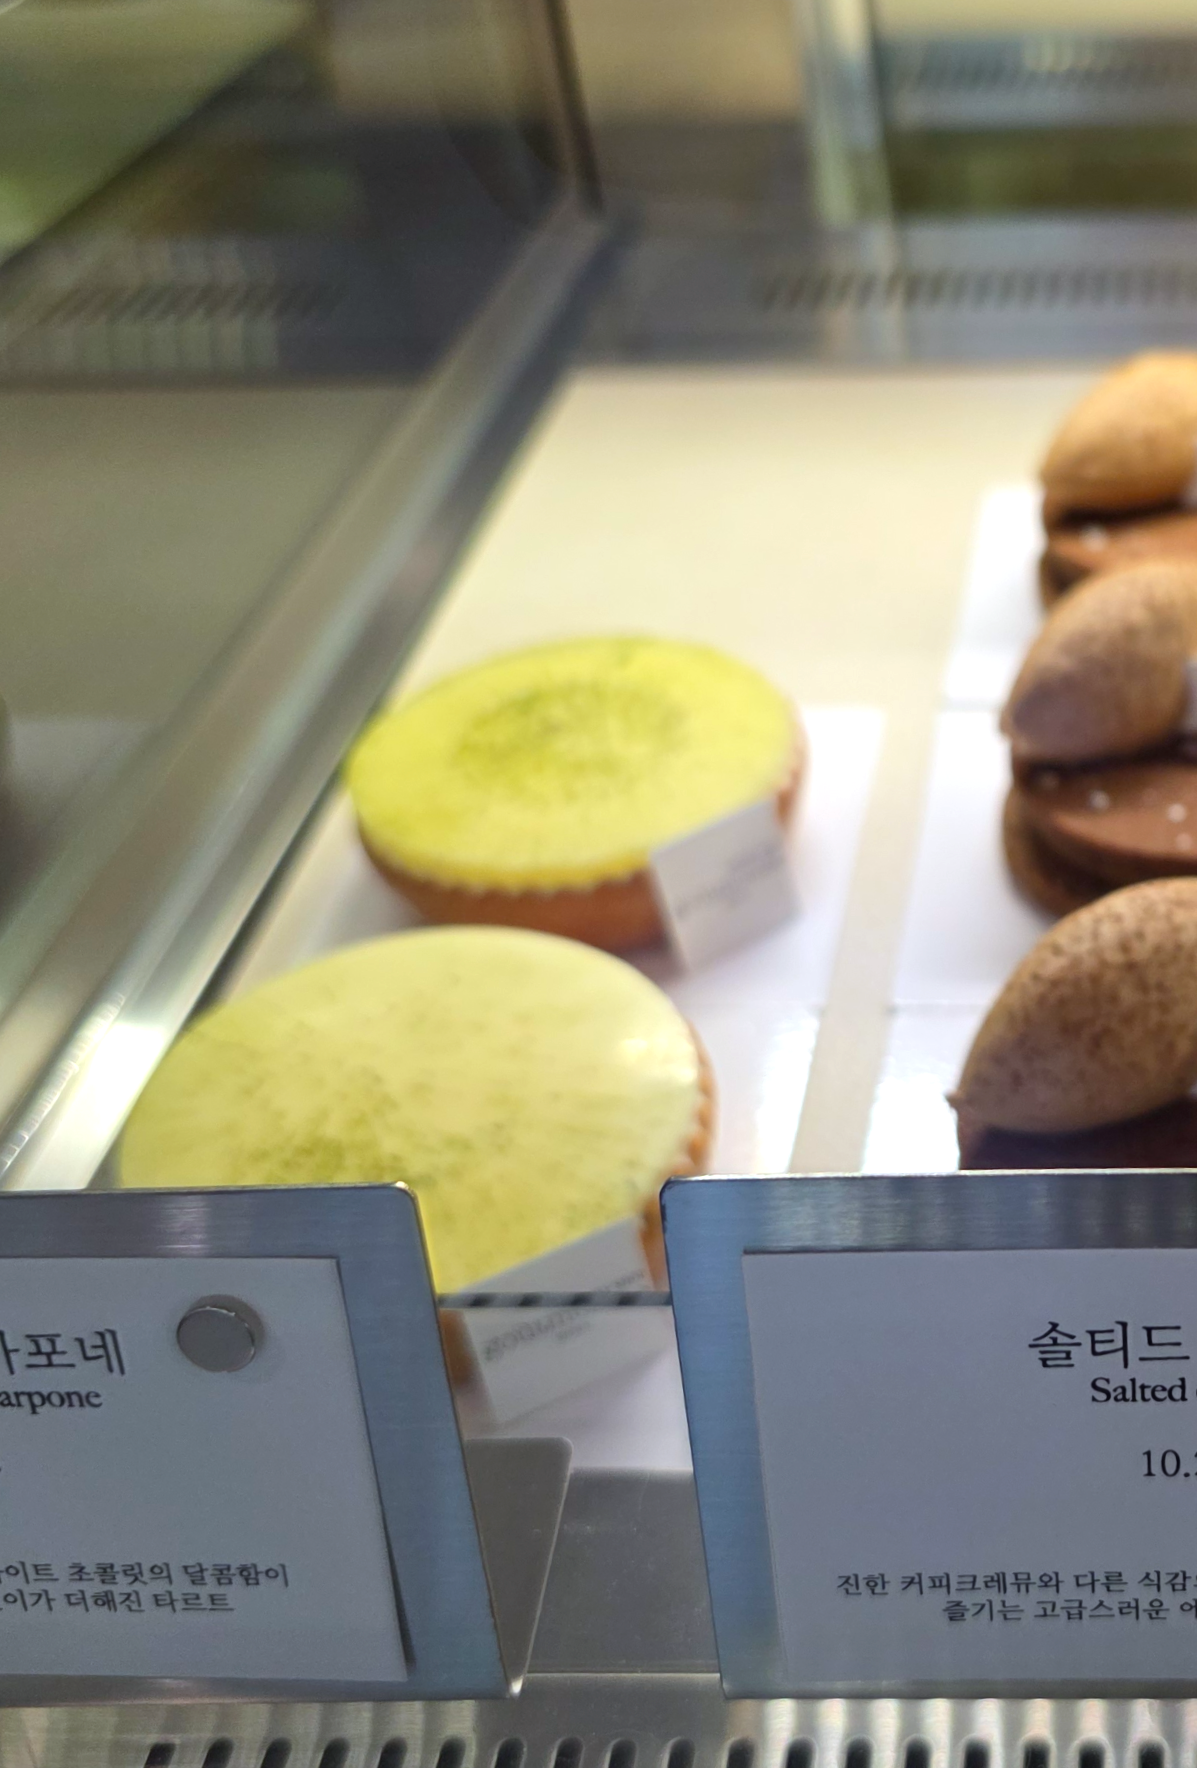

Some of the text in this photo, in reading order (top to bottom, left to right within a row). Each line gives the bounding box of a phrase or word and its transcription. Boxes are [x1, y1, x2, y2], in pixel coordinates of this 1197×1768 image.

[1028, 1321, 1190, 1369] 솔티드
[1090, 1376, 1188, 1403] Salted
[0, 1560, 289, 1588] 이트 초콜릿의 달콤함이
[836, 1572, 891, 1596] 진한
[901, 1571, 1065, 1595] 커피크레뮤와
[1073, 1570, 1129, 1594] 다른
[0, 1588, 235, 1613] 이가 더해진 타르트
[942, 1599, 1025, 1622] 즐기는
[1033, 1598, 1170, 1622] 고급스러운
